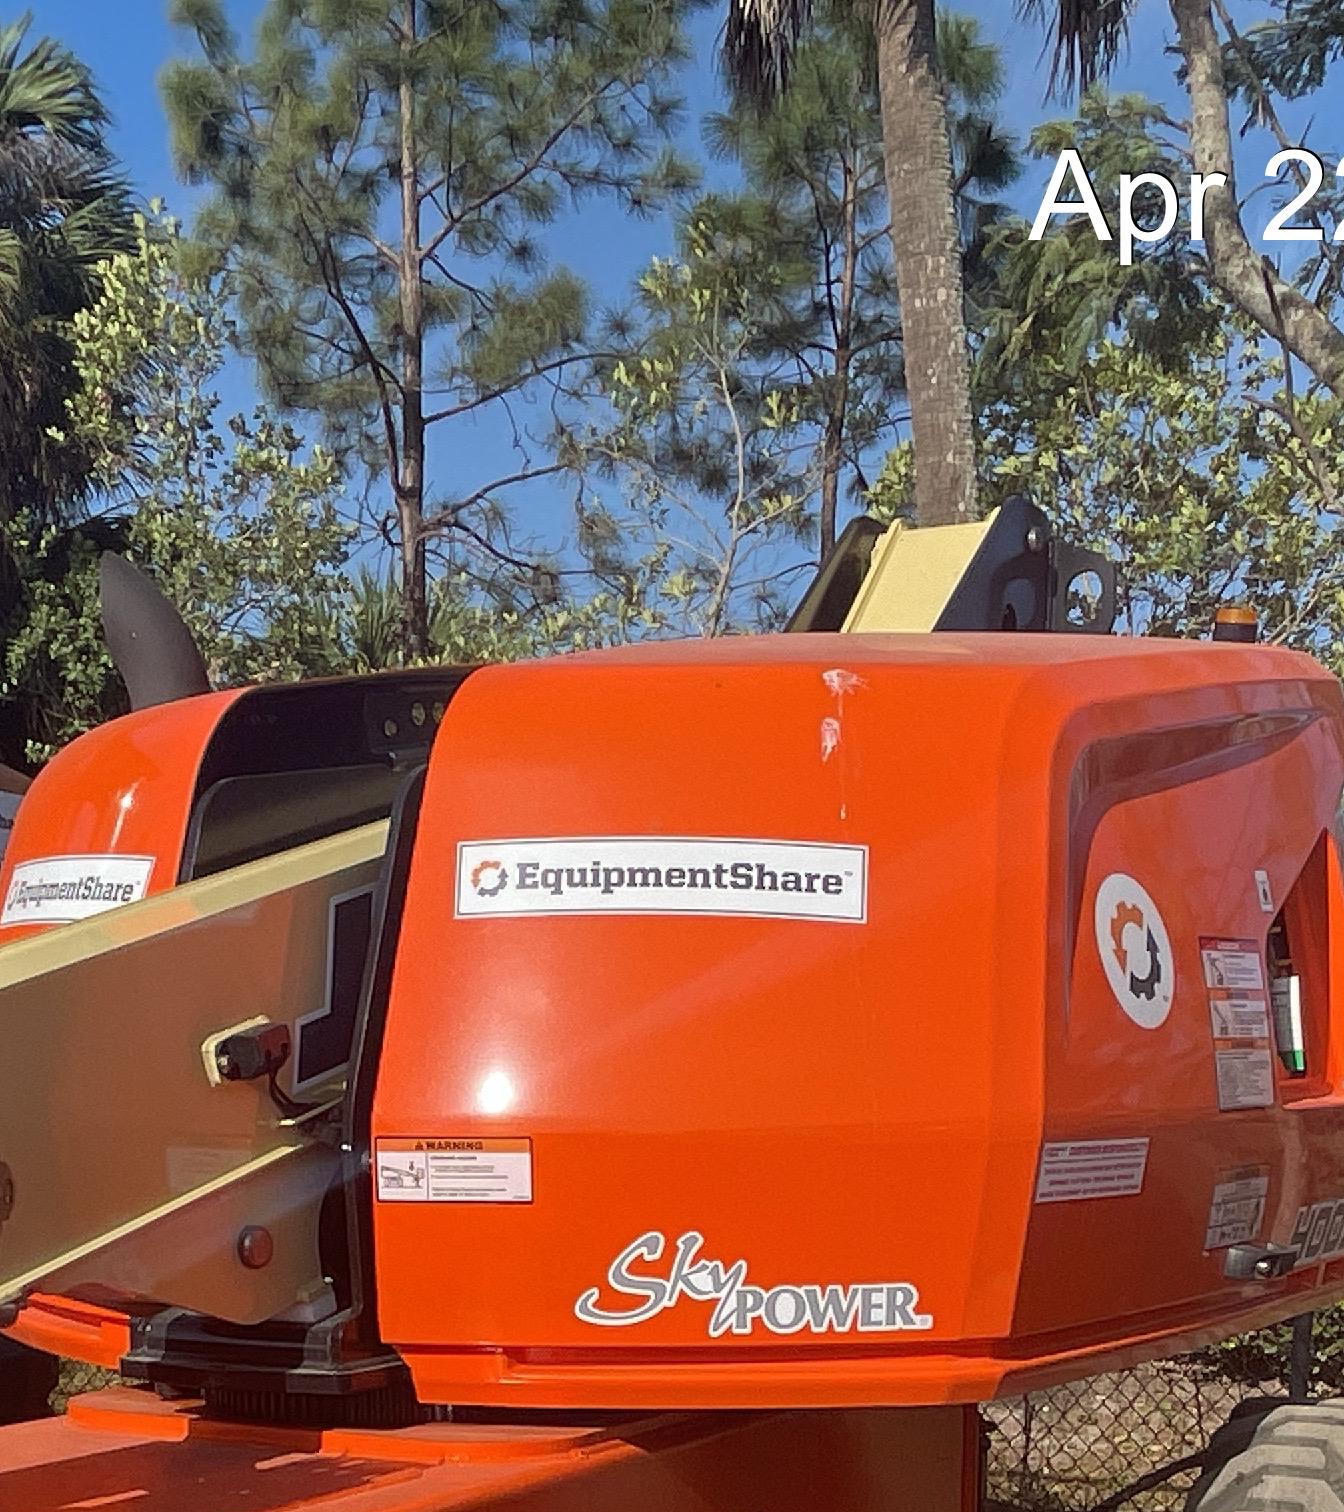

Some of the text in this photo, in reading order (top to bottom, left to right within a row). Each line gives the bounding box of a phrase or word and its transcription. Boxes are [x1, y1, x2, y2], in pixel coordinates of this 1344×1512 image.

[18, 876, 133, 908] EquipmentShare
[515, 860, 843, 895] EquipmentShare
[732, 1283, 916, 1334] POWER
